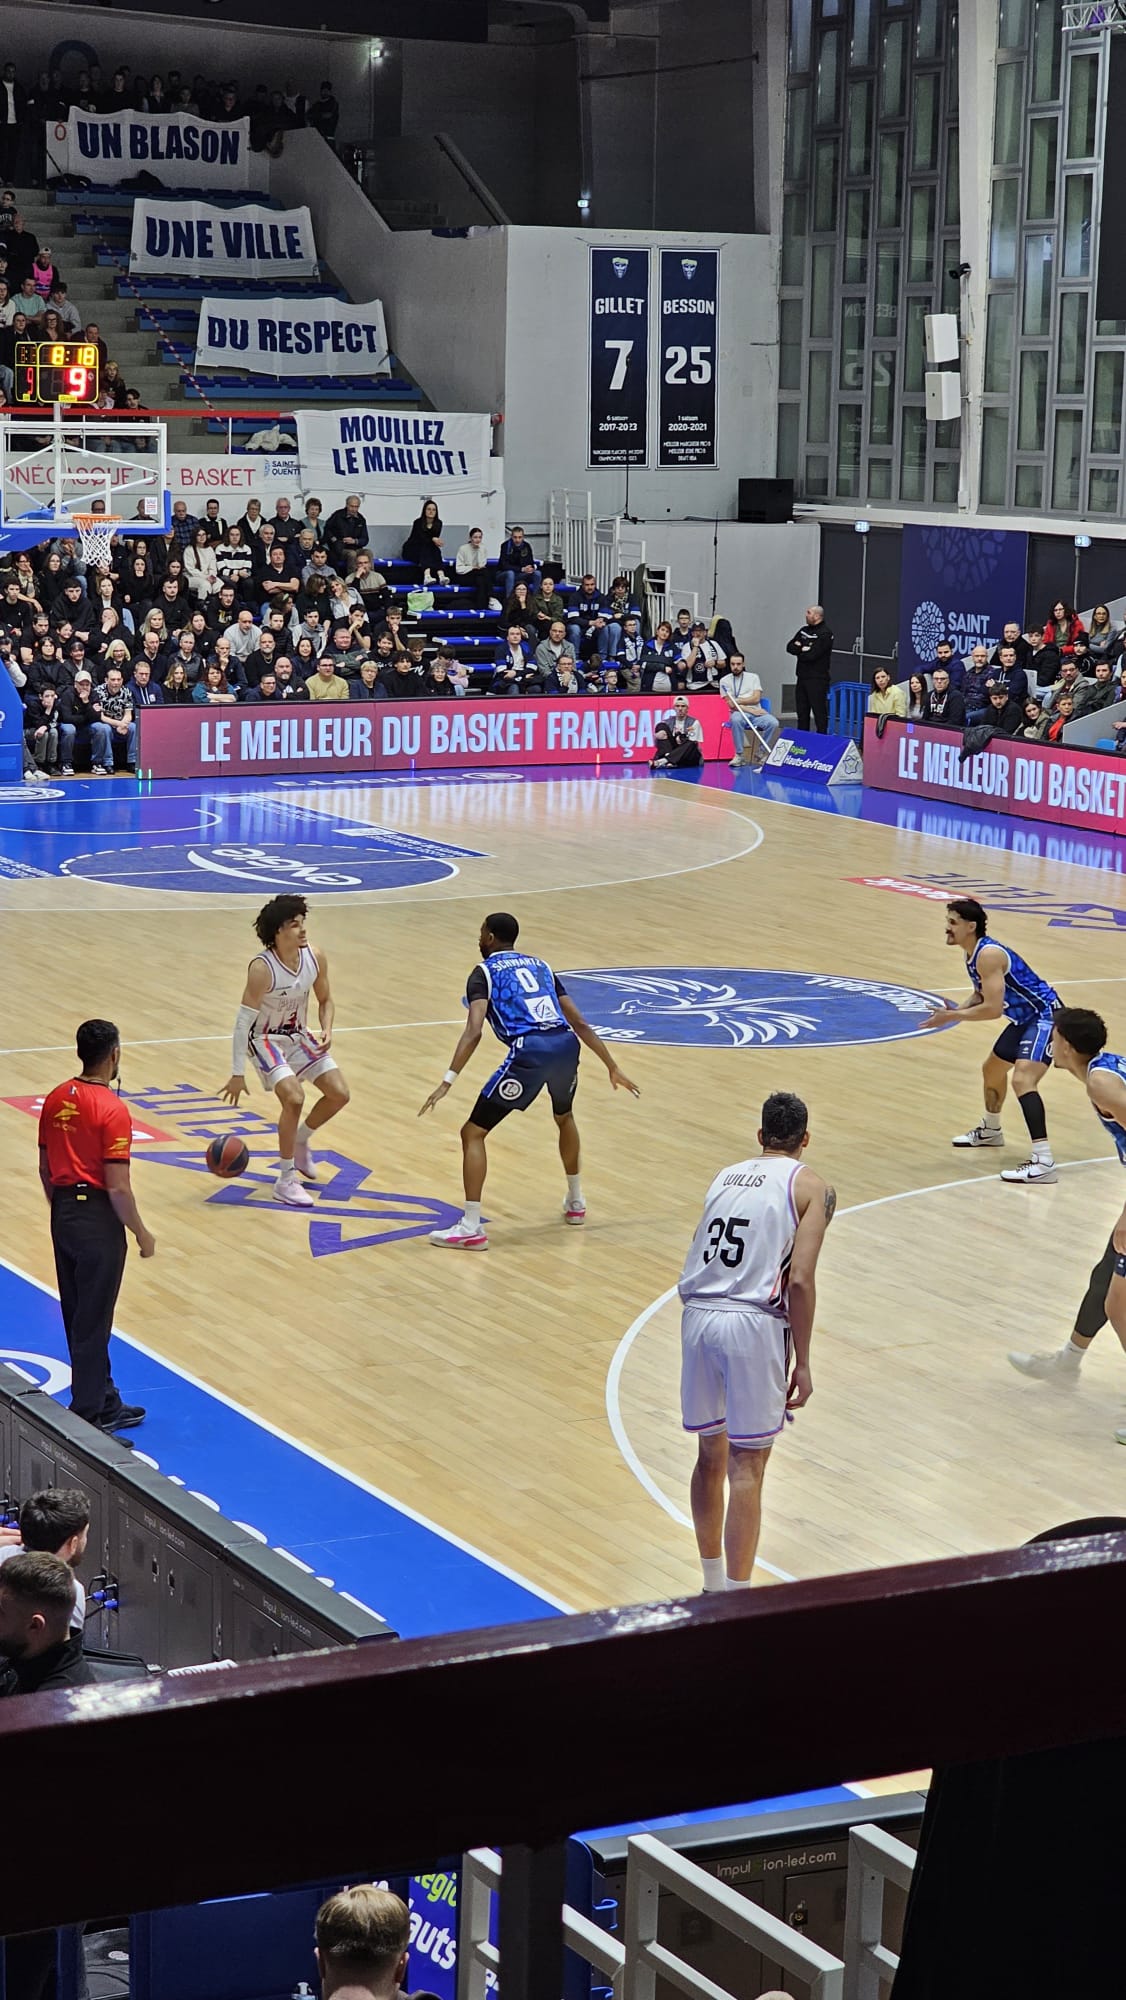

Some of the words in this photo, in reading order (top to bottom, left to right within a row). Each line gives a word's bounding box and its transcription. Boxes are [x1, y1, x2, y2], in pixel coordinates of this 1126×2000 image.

[77, 121, 122, 159] UN
[129, 124, 240, 165] BLASON
[146, 216, 213, 258] UNE
[220, 221, 305, 259] VILLE
[595, 297, 645, 315] GILLET
[663, 299, 715, 315] BESSON
[207, 316, 249, 351] DU
[257, 317, 377, 354] RESPECT
[52, 346, 95, 366] 8:18
[604, 340, 634, 390] 7
[664, 345, 712, 385] 25
[69, 367, 87, 398] 9
[339, 414, 445, 446] MOUILLEZ
[668, 423, 707, 431] 2020-2021
[272, 460, 295, 468] SAINT
[332, 447, 359, 476] LE
[363, 446, 456, 476] MAILLOT
[458, 450, 468, 476] !
[180, 468, 257, 487] BASKET
[947, 611, 991, 635] SAINT
[200, 720, 231, 762] LE
[240, 717, 372, 761] MEILLEUR
[382, 715, 421, 756] DU
[430, 711, 538, 754] BASKET
[898, 737, 920, 780] LE
[923, 741, 1010, 798] MEILLEUR
[1014, 757, 1044, 803] DU
[1047, 763, 1126, 818] BASKET
[491, 957, 543, 972] SCHWARTZ
[515, 967, 540, 993] 0
[722, 1174, 767, 1188] WILLIS
[703, 1216, 751, 1269] 35
